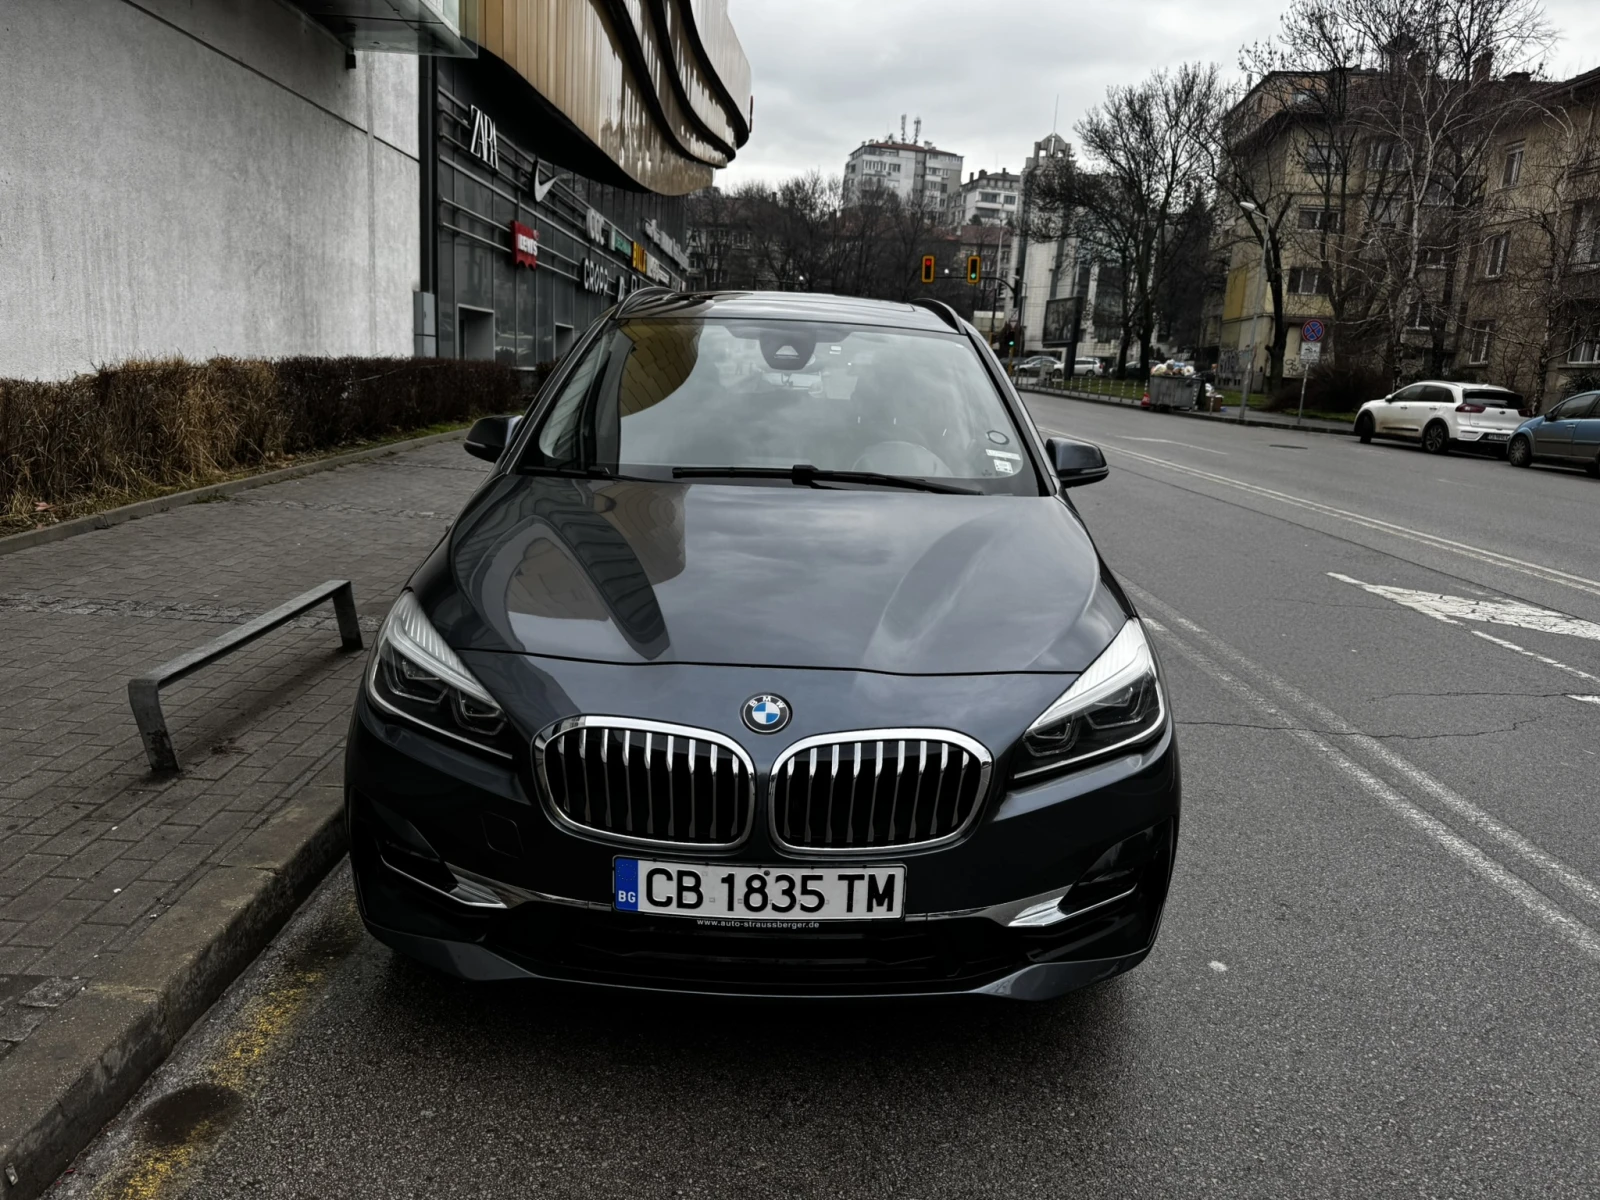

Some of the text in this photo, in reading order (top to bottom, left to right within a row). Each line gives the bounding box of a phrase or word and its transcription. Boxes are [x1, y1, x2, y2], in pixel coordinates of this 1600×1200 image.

[471, 104, 499, 169] ZARA
[749, 695, 786, 709] BMW
[618, 890, 636, 903] BG
[646, 867, 896, 913] CB 1835 TM
[697, 919, 820, 930] www.auto-straussberger.de
